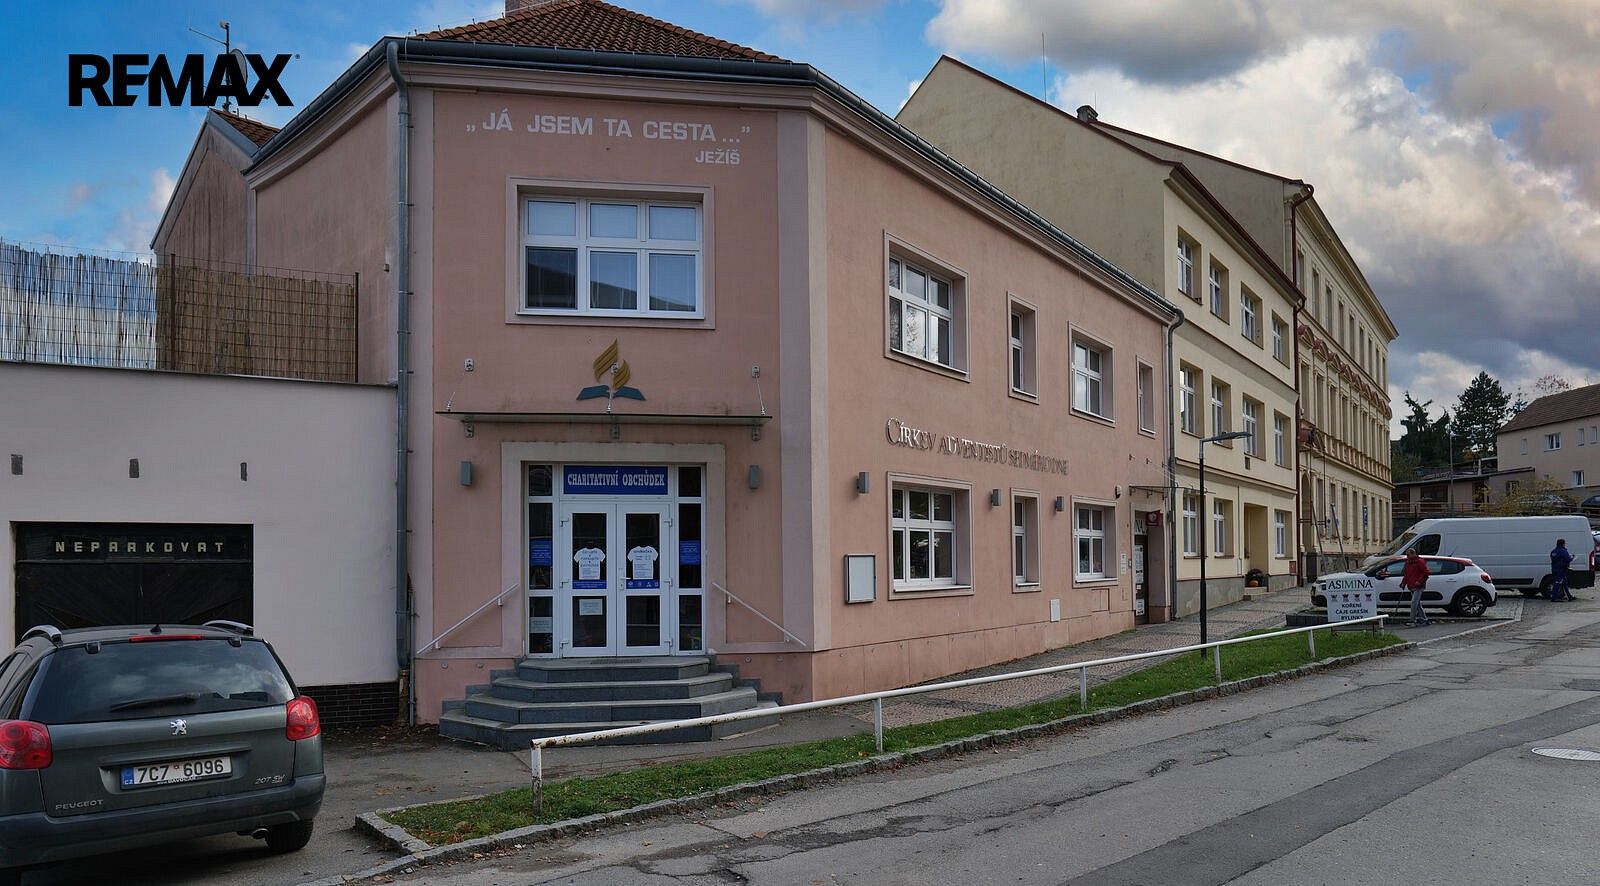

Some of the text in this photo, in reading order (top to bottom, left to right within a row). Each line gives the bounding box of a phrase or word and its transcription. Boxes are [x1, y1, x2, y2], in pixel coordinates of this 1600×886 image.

[527, 114, 593, 136] JSEM
[604, 118, 633, 138] TA
[695, 149, 741, 165] JEŽÍŠ
[567, 470, 665, 487] CHARITATIVNÍ OBCHŮDEK
[55, 541, 224, 553] NEPARKOVAT
[1328, 580, 1373, 589] ASIMINA
[137, 765, 170, 783] 7C7
[183, 760, 224, 777] 6096
[55, 799, 104, 810] PEUGEOT
